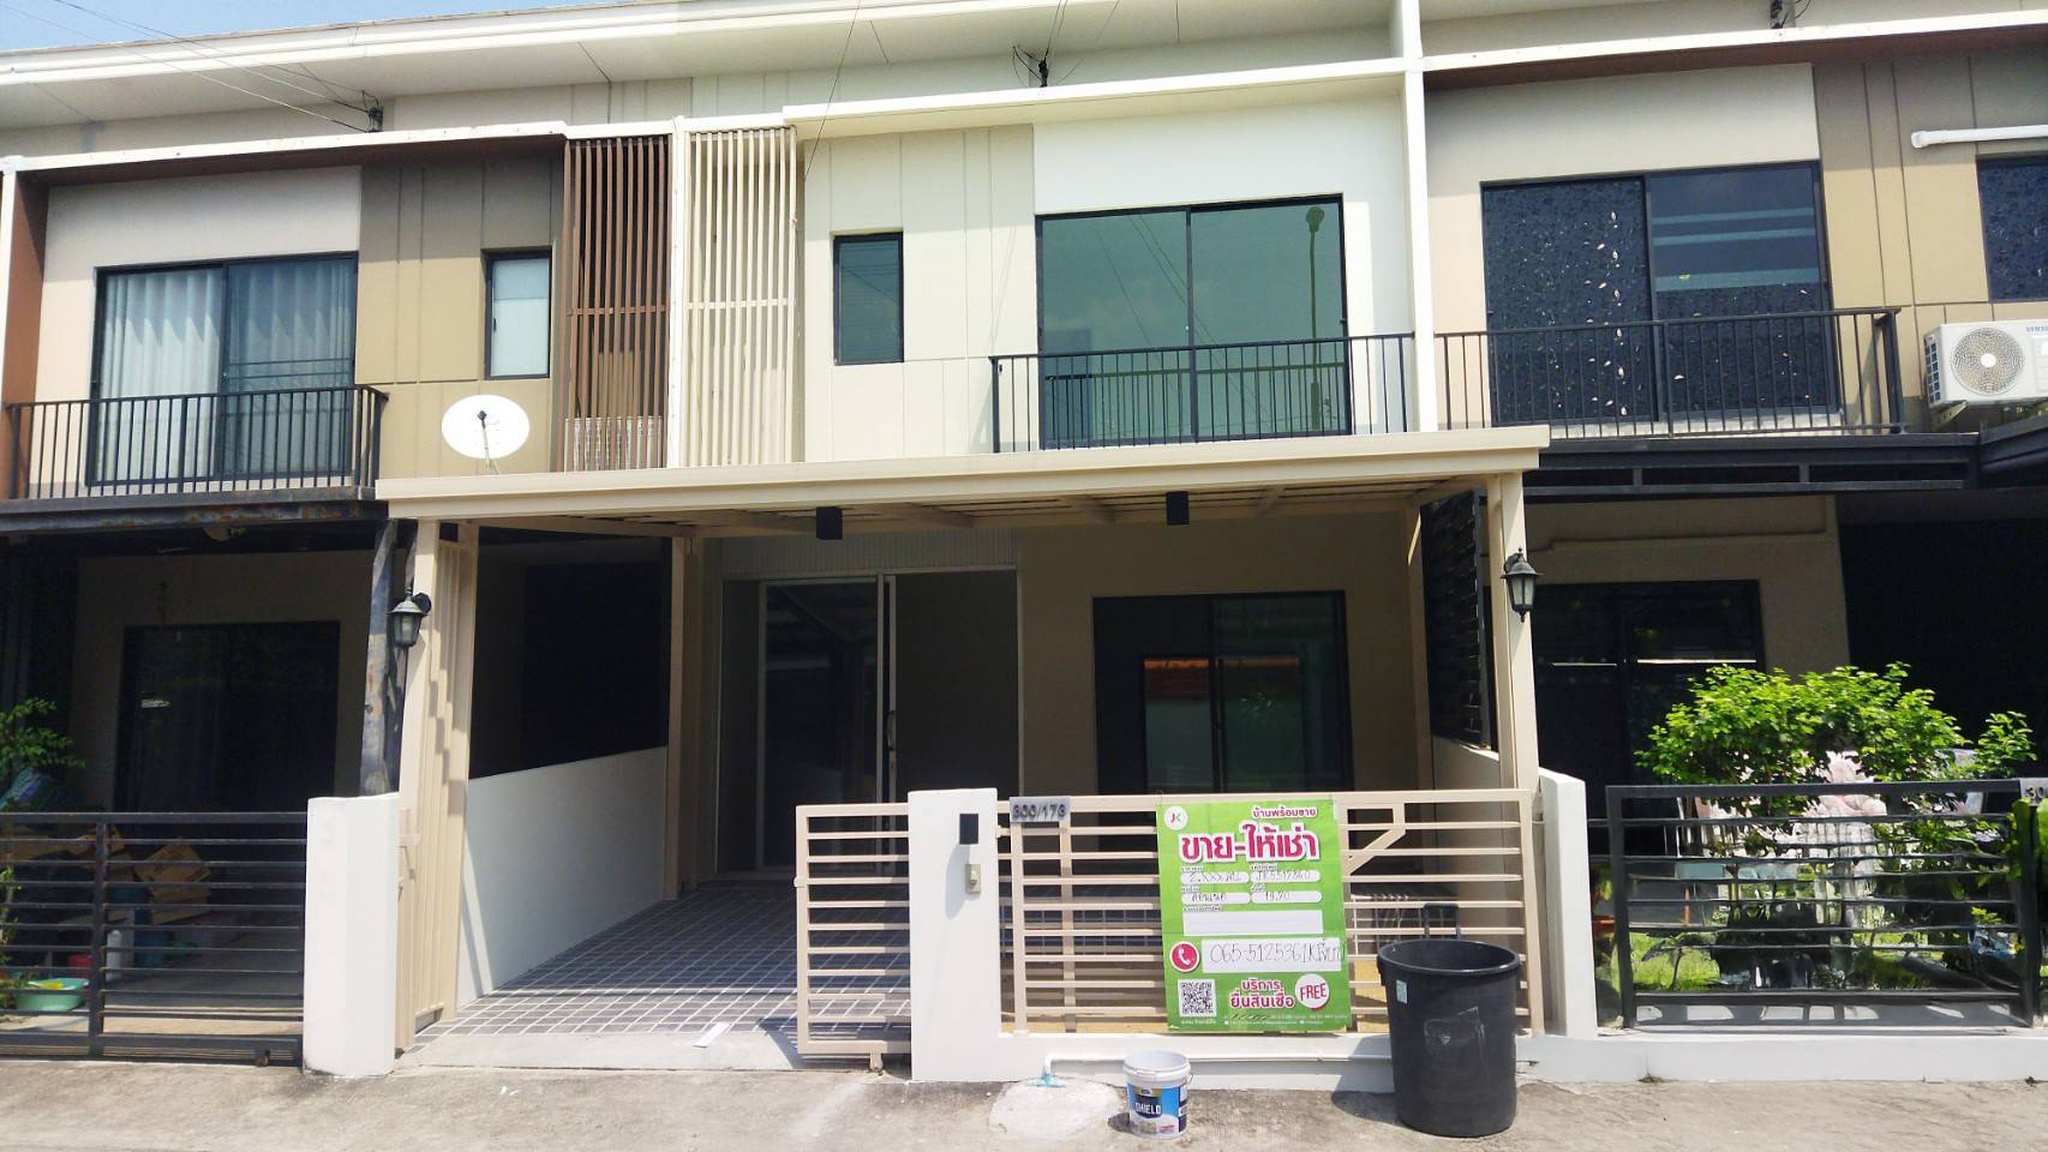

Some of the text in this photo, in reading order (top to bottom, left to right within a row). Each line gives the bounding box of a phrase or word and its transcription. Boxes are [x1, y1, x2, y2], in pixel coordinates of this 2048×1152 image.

[1181, 823, 1317, 860] ขาย-ให้เช่า
[1242, 978, 1281, 991] บริการ
[1300, 982, 1327, 1001] FREE
[1230, 989, 1295, 1008] ยื่นสินเชื่อ
